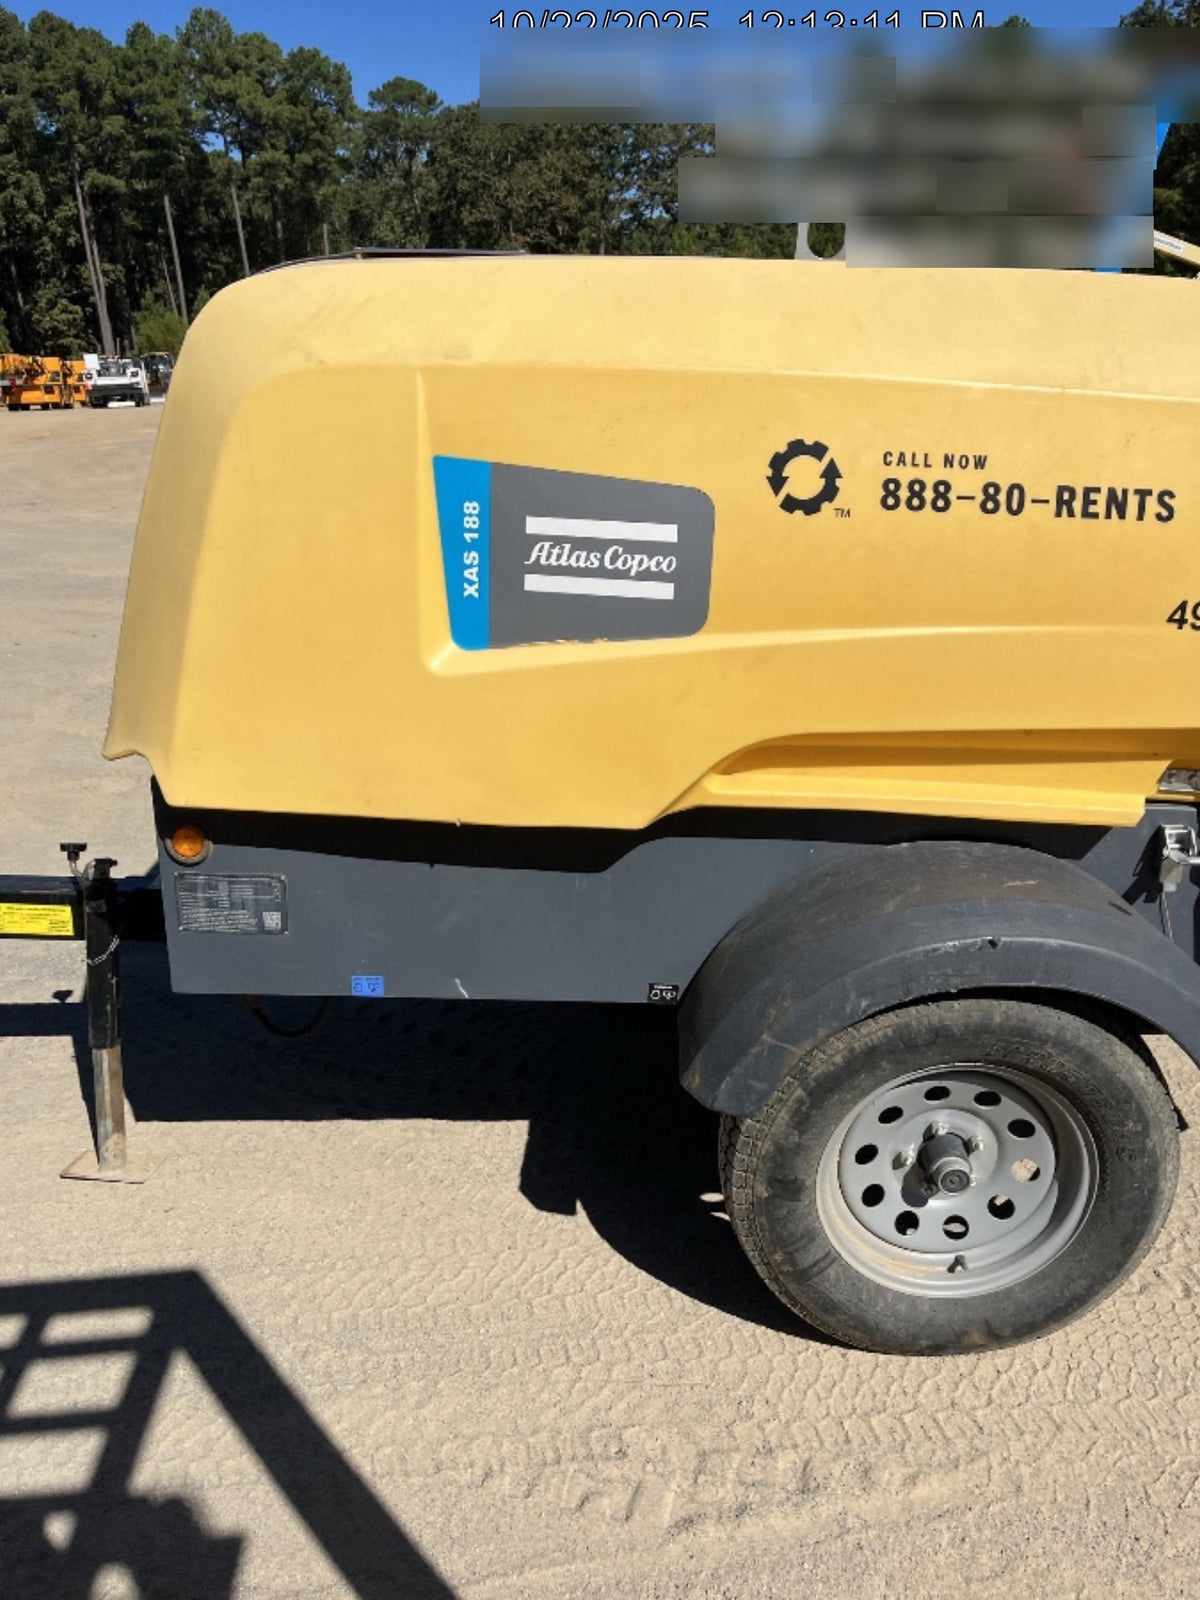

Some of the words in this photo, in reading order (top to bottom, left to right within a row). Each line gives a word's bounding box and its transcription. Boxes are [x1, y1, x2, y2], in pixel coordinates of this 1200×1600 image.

[882, 451, 932, 468] CALL
[943, 453, 988, 470] NOW
[880, 477, 1176, 523] 888-80-RENTS
[463, 501, 480, 543] 188
[463, 551, 480, 598] XAS
[524, 541, 601, 569] Atlas
[603, 545, 677, 576] Copco
